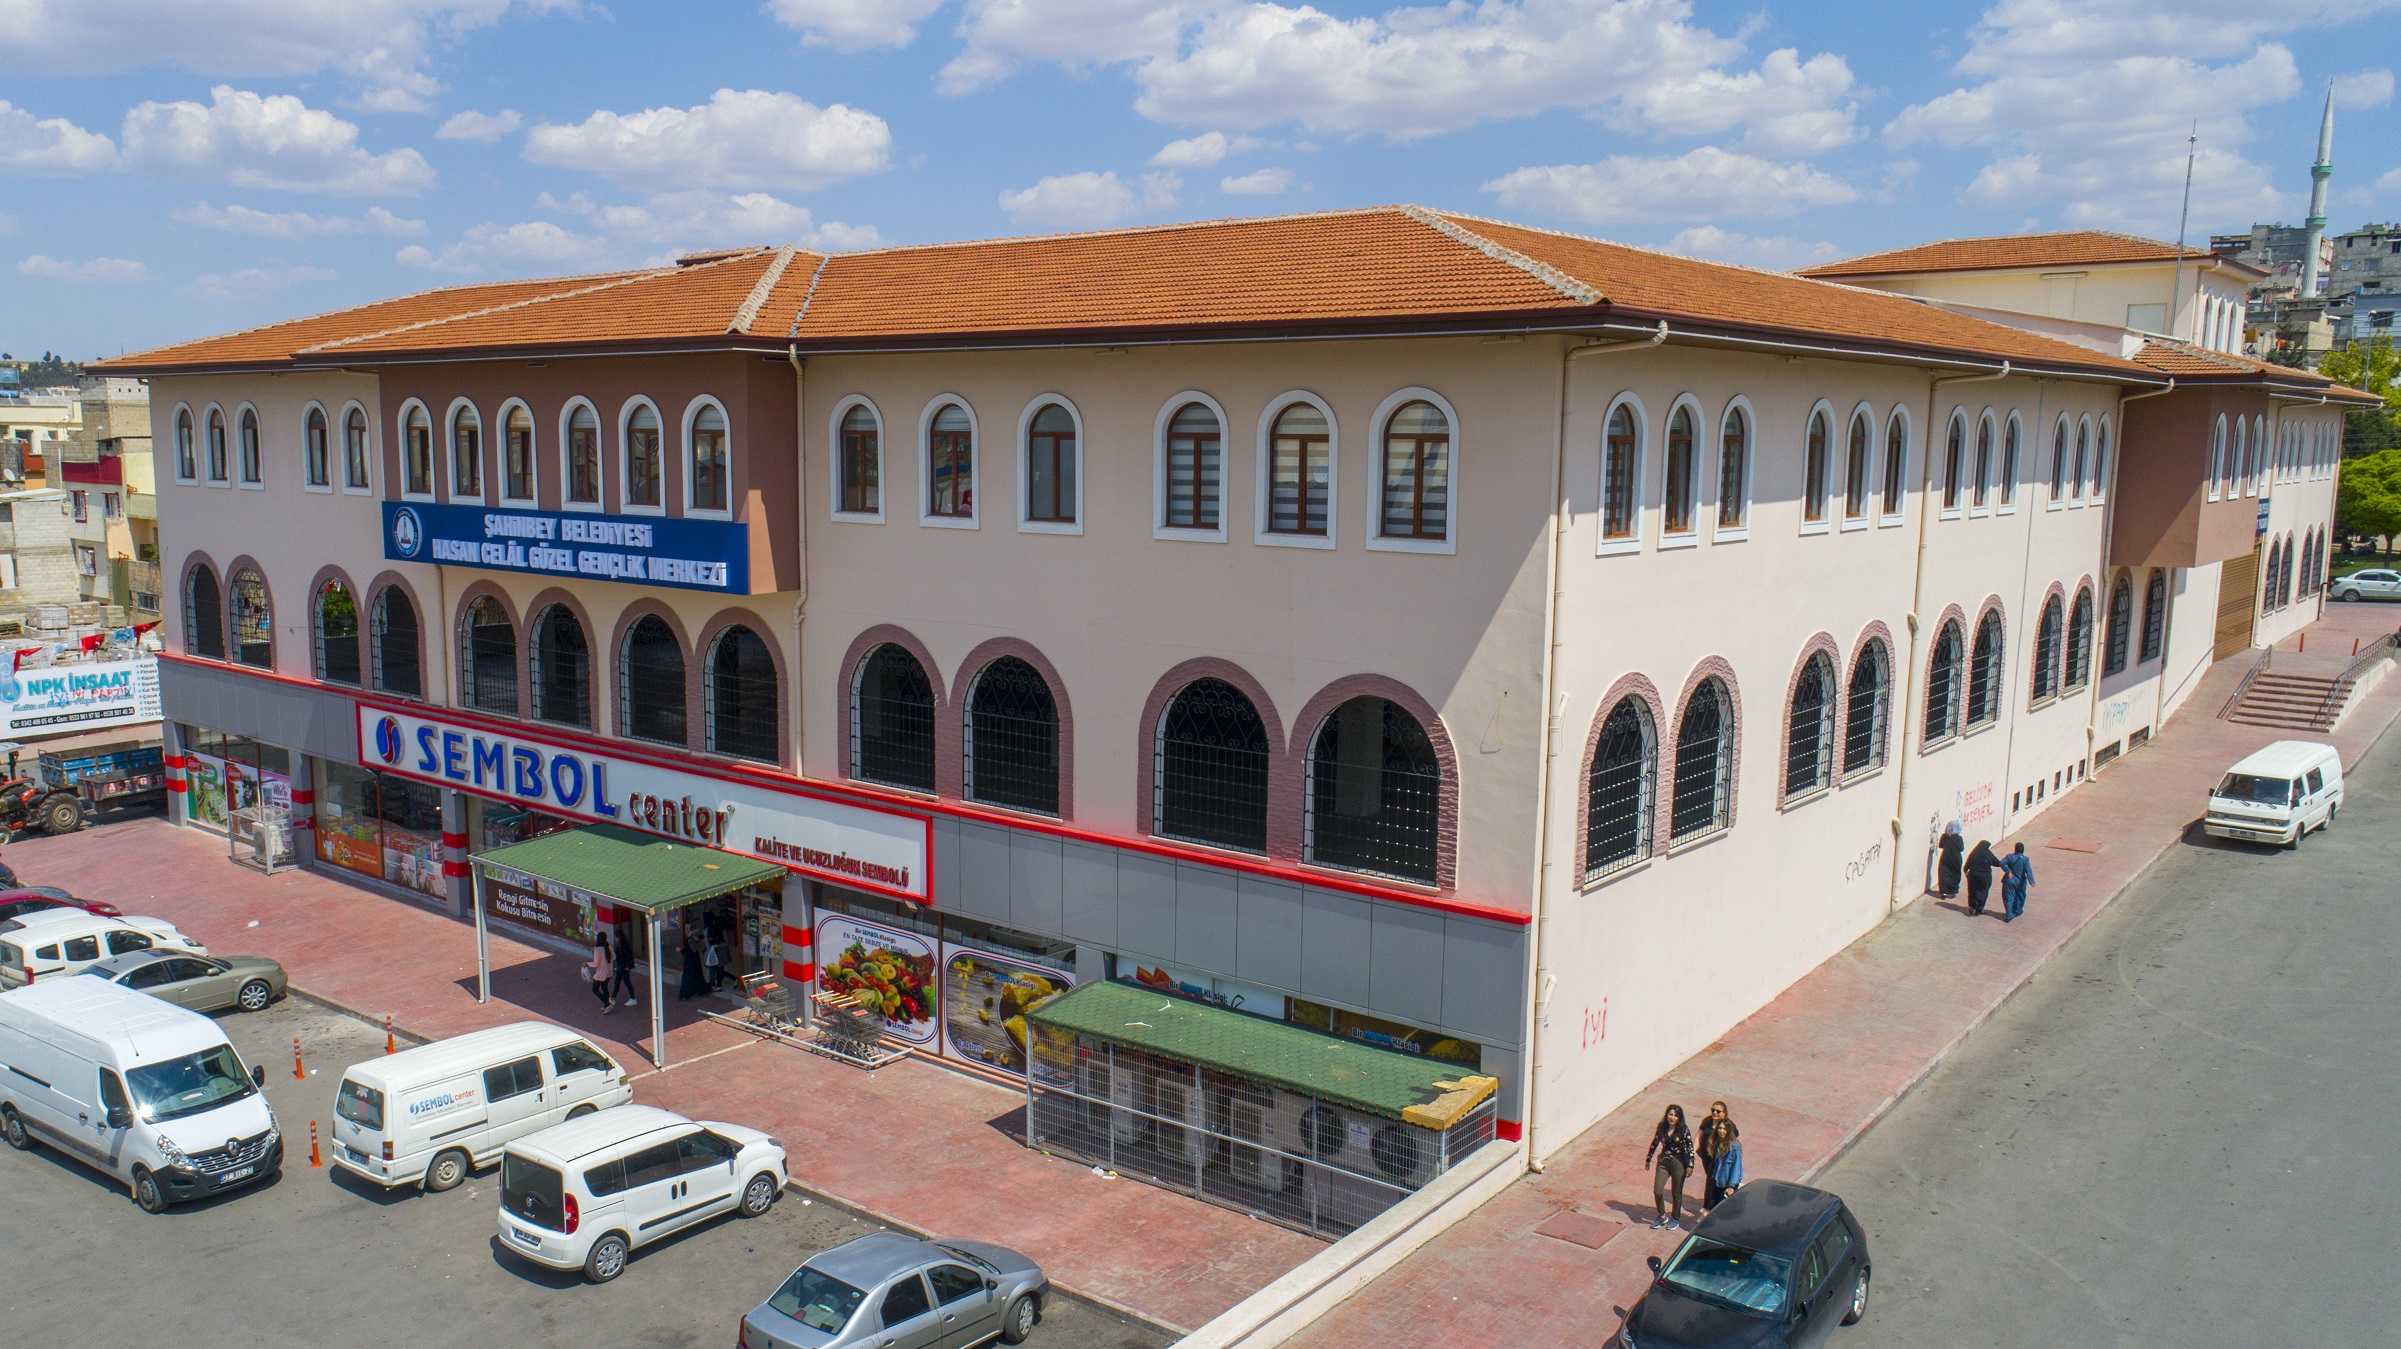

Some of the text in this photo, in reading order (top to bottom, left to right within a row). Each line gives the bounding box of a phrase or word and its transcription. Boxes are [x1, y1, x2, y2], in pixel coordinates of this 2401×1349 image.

[432, 538, 480, 563] HASAN
[481, 540, 528, 567] CELÂL
[529, 542, 577, 571] GÜZEL
[578, 550, 647, 579] GENÇLİK
[648, 556, 728, 587] MERKEZİ
[28, 677, 66, 696] NPK
[417, 724, 729, 849] SEMBOL center
[755, 836, 910, 888] KALİTE VE UCUZLUĞUN SEMBOLÜ
[496, 899, 552, 926] Kokusu Bitmesin
[498, 888, 549, 913] Rengi Gitmesin
[843, 932, 851, 940] EN
[851, 934, 864, 943] TAZE
[865, 937, 882, 948] SEBZE
[882, 942, 890, 950] VE
[1169, 980, 1179, 990] Bir
[892, 1021, 911, 1033] SEMBOL
[1352, 1027, 1363, 1038] Bir
[419, 1089, 475, 1113] SEMBOL center
